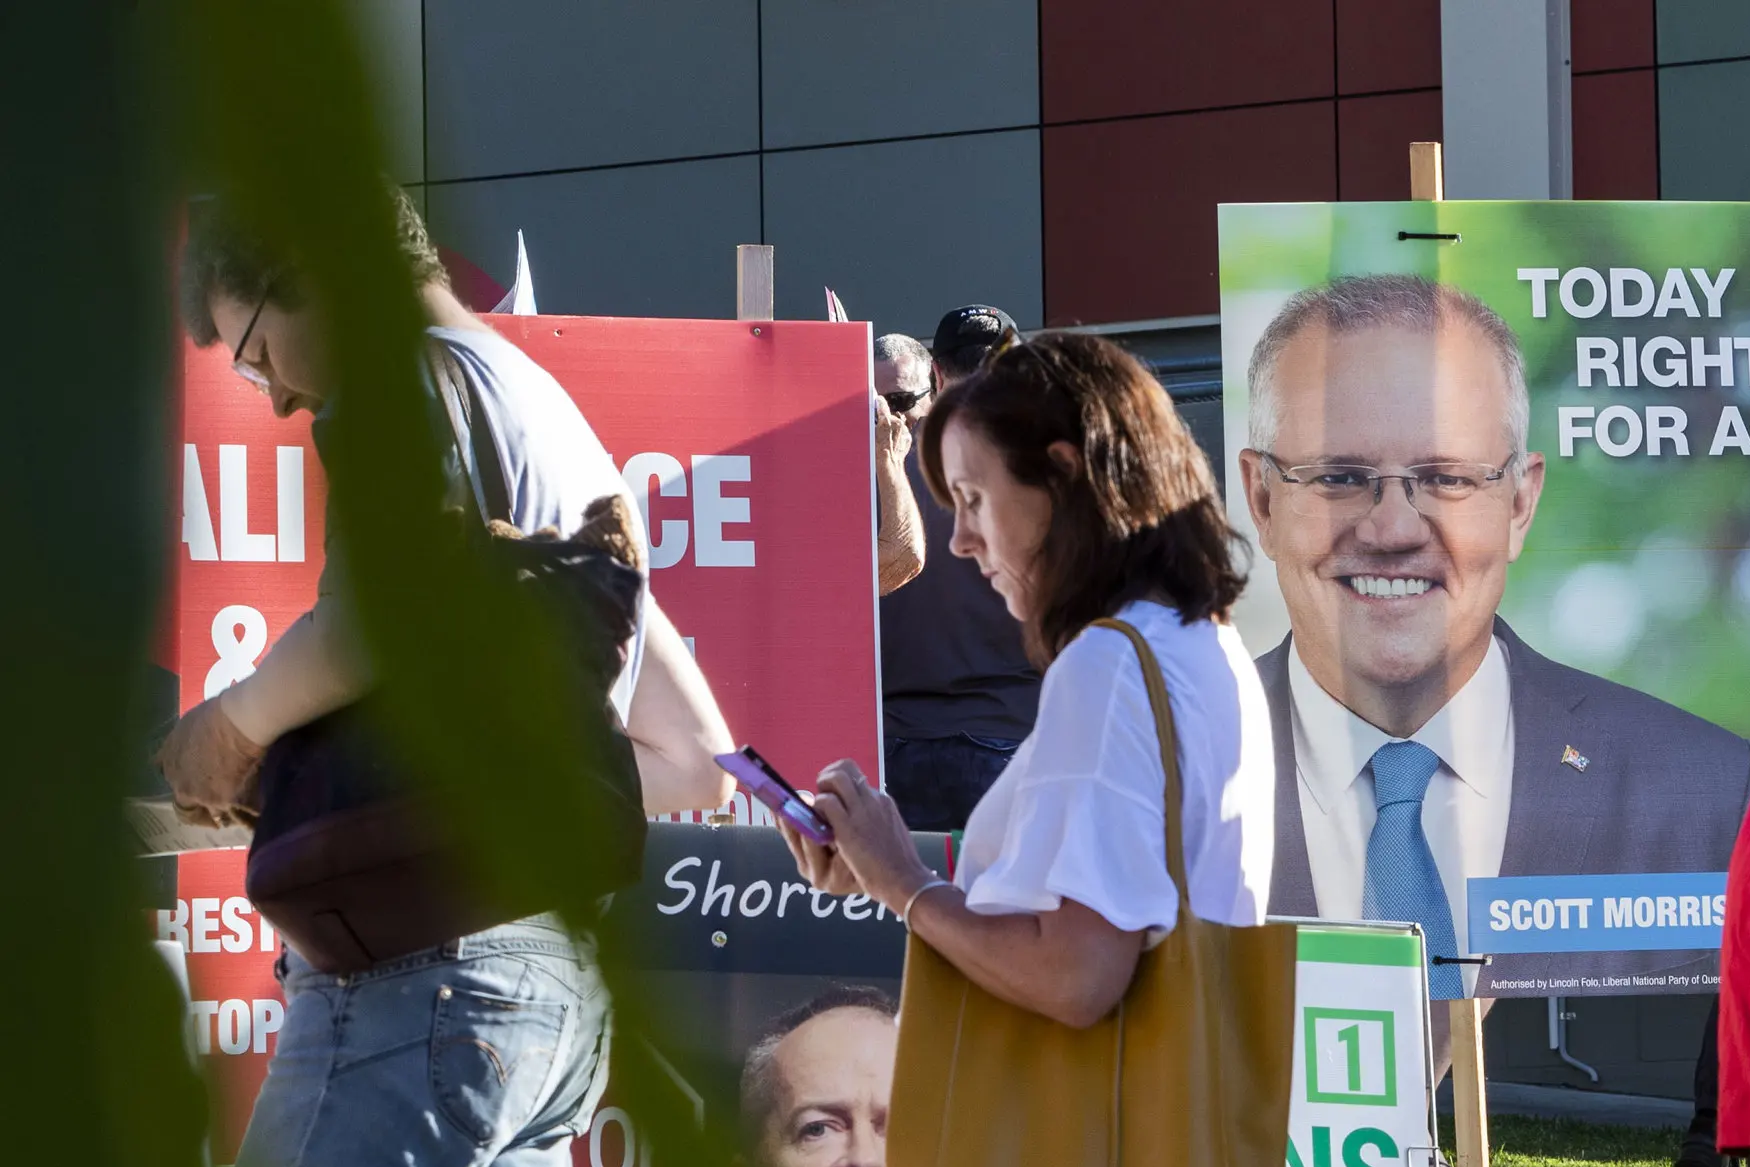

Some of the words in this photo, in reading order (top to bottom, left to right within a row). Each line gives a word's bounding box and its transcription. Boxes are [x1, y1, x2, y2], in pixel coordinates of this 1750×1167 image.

[1517, 267, 1737, 319] TODAY
[1557, 405, 1691, 458] FOR
[1489, 897, 1594, 932] SCOTT
[1490, 978, 1535, 989] Authorised
[1536, 979, 1548, 991] by
[1549, 978, 1579, 988] Lincoln
[1602, 977, 1631, 987] Liberal
[1632, 977, 1666, 987] National
[1668, 976, 1690, 988] Party
[1691, 975, 1700, 985] of
[1337, 1024, 1361, 1091] 1
